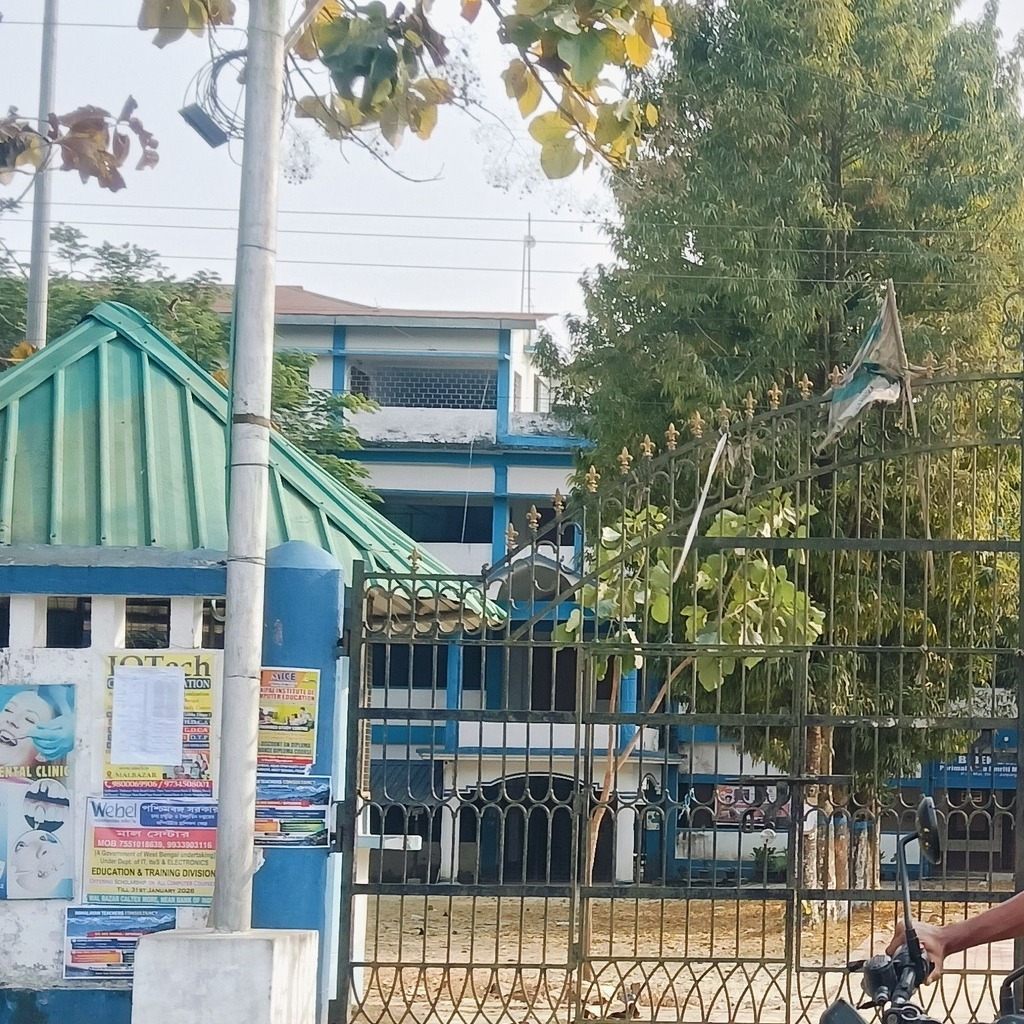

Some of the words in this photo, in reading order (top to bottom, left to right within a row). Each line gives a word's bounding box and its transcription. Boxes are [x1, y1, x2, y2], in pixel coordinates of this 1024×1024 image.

[184, 680, 210, 689] ATION
[0, 765, 33, 778] ENTAL
[35, 765, 70, 778] CLINIC
[90, 801, 137, 818] Webel
[115, 829, 142, 837] মাল
[97, 839, 117, 847] MOB
[159, 851, 179, 859] Bengal
[91, 867, 135, 876] EDUCATION
[137, 868, 143, 876] &
[144, 868, 181, 877] TRAINING
[182, 869, 216, 878] DIVISION
